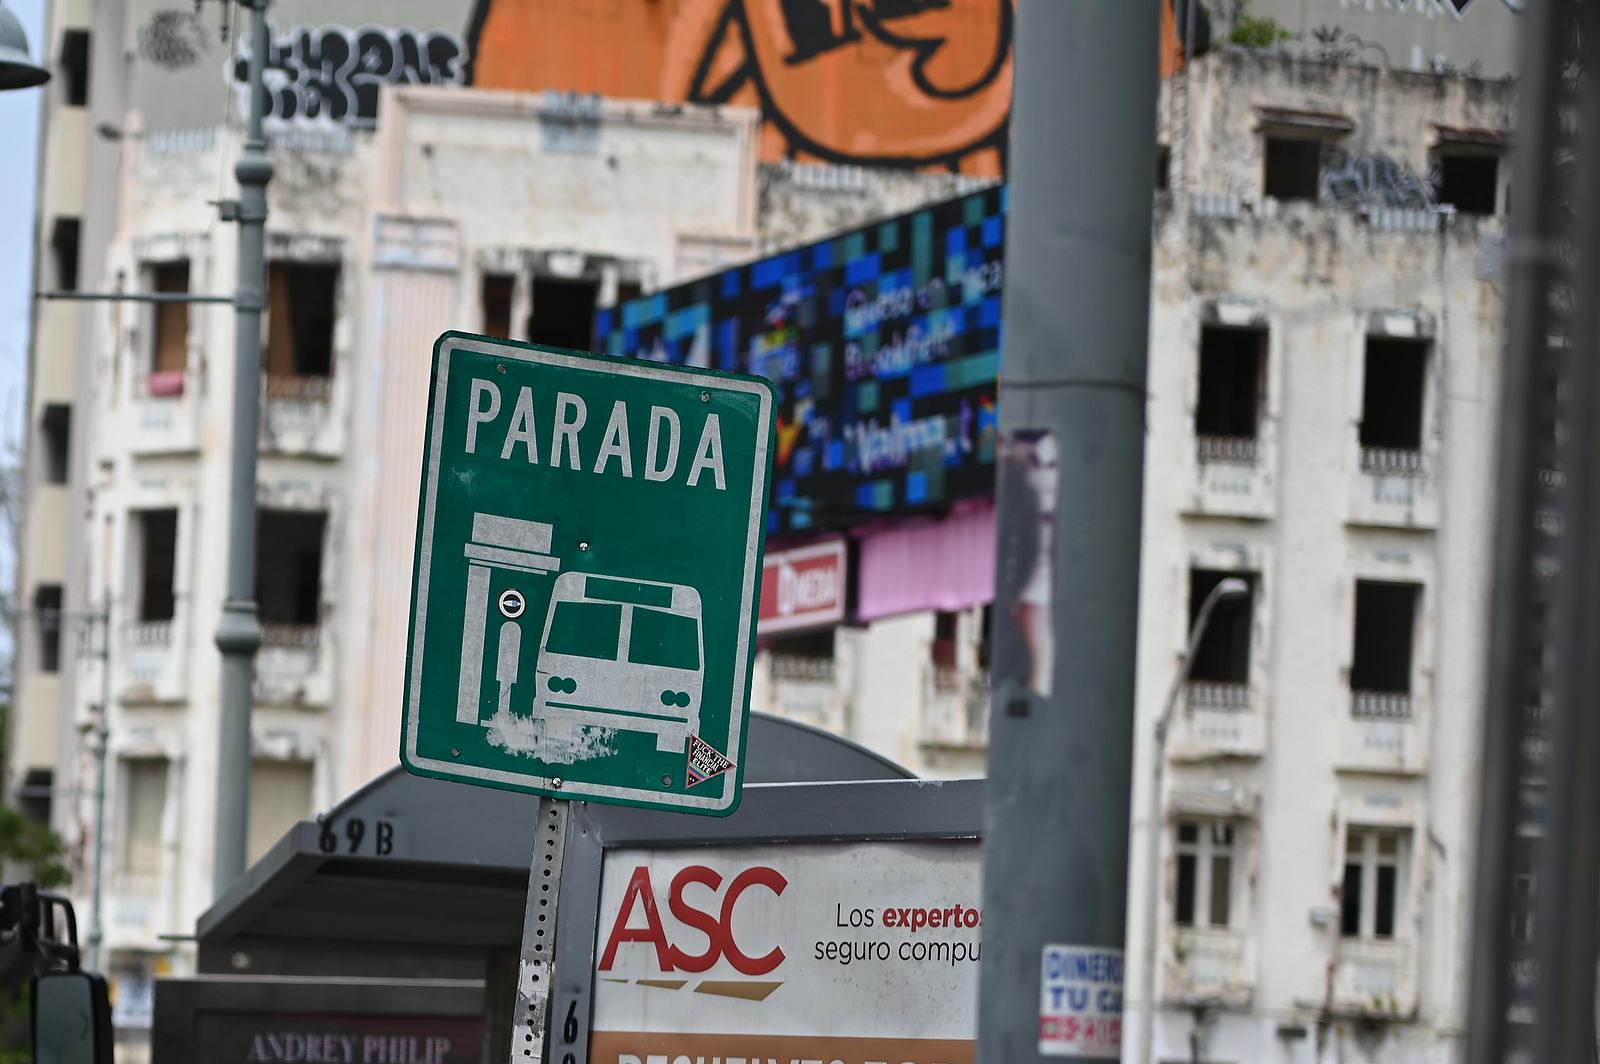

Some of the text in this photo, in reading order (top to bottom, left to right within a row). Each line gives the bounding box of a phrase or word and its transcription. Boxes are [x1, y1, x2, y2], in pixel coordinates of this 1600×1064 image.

[465, 377, 728, 490] PARADA
[692, 739, 730, 769] FUCK THE
[692, 749, 720, 772] FINANCIAL
[692, 758, 713, 775] ELITE
[598, 865, 789, 976] ASC
[836, 902, 874, 930] Los
[814, 939, 891, 965] seguro
[247, 1034, 354, 1064] ANDREY
